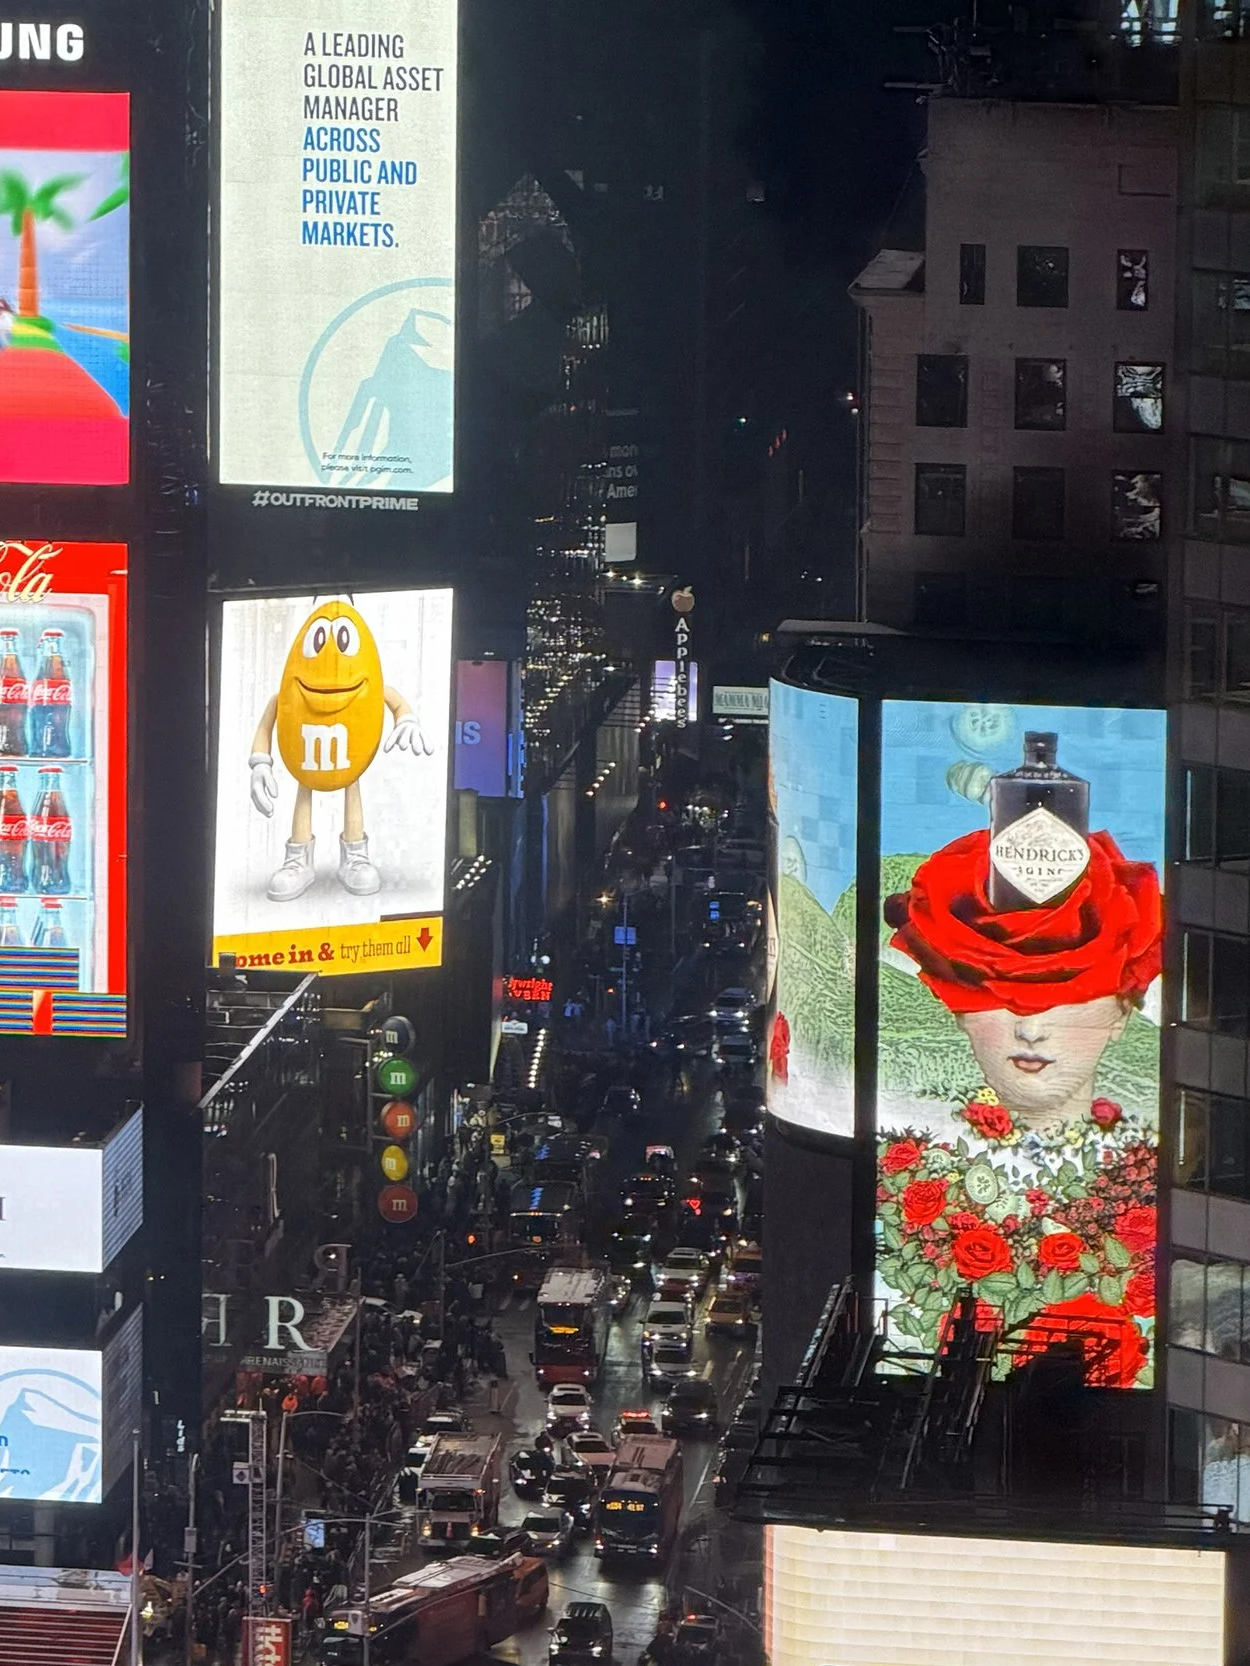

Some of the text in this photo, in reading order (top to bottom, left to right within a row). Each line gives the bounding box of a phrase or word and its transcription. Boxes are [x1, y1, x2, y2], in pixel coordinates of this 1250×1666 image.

[304, 32, 405, 58] A LEADING
[304, 63, 444, 92] GLOBAL ASSET
[303, 95, 399, 122] MANAGER
[303, 126, 381, 153] ACROSS
[302, 157, 418, 186] PUBLIC AND
[302, 189, 382, 216] PRIVATE
[302, 220, 400, 248] MARKETS.
[321, 463, 350, 473] please
[322, 452, 337, 461] For
[338, 453, 360, 462] more
[252, 490, 419, 511] #OUTFRONTPRIME
[301, 723, 351, 771] m
[234, 935, 412, 969] ome in & try them all
[390, 1071, 406, 1085] m
[263, 1295, 324, 1352] R
